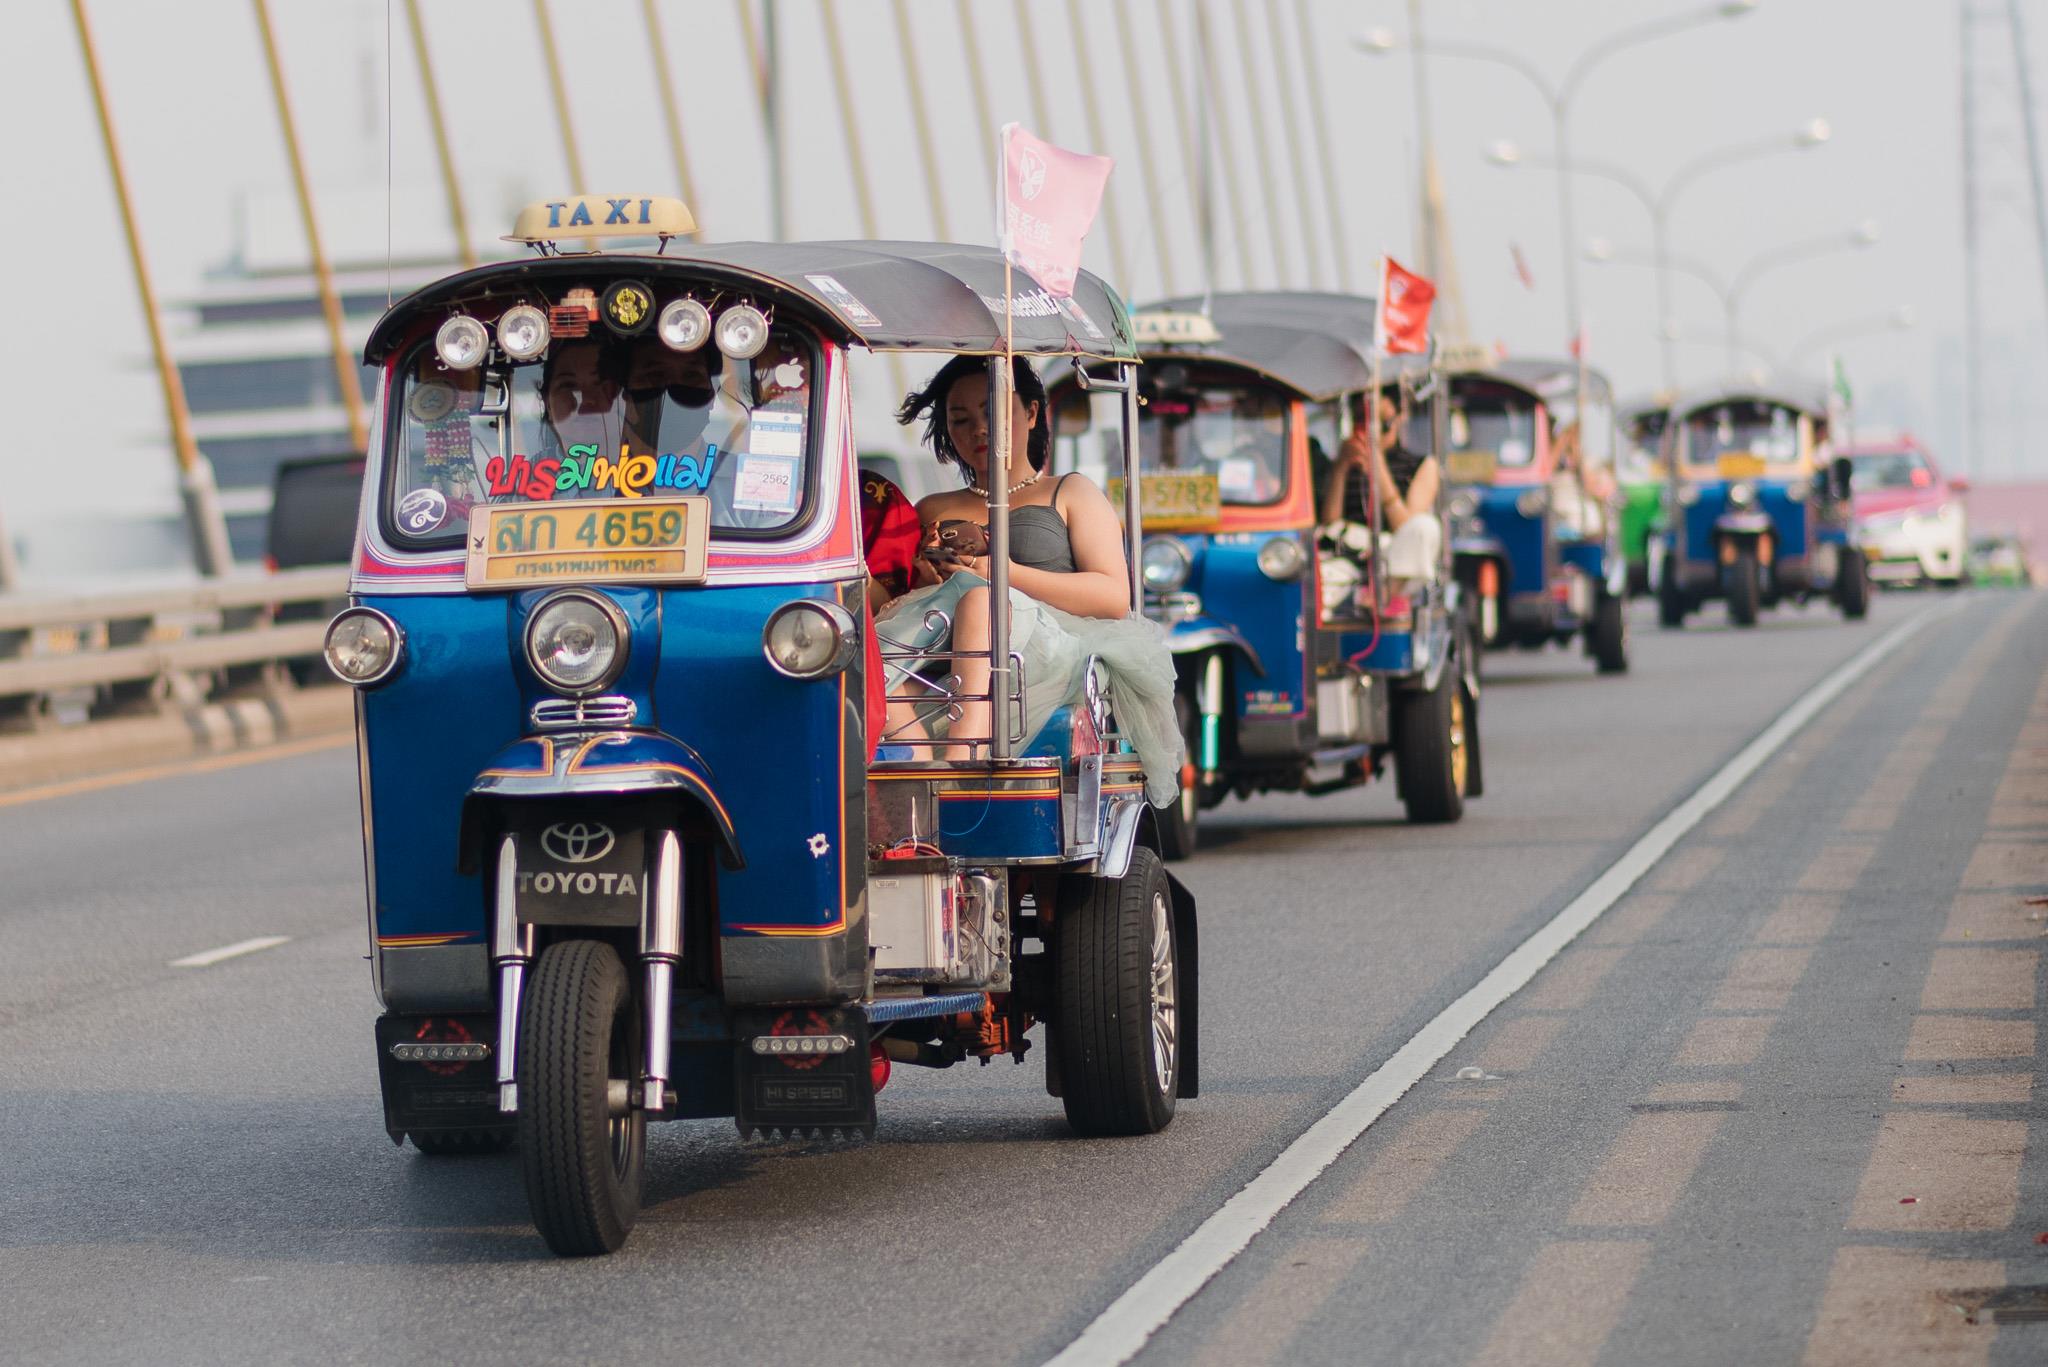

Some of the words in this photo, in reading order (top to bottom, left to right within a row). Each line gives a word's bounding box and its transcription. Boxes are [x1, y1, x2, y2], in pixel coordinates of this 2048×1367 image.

[546, 199, 653, 228] TAXI
[1135, 320, 1193, 333] TAXI
[485, 443, 718, 501] บารมีพ่อแม่
[762, 474, 789, 486] 2562
[575, 511, 683, 548] 4659
[515, 556, 657, 577] กรุงเทพมหานคร
[517, 872, 638, 895] TOYOTA
